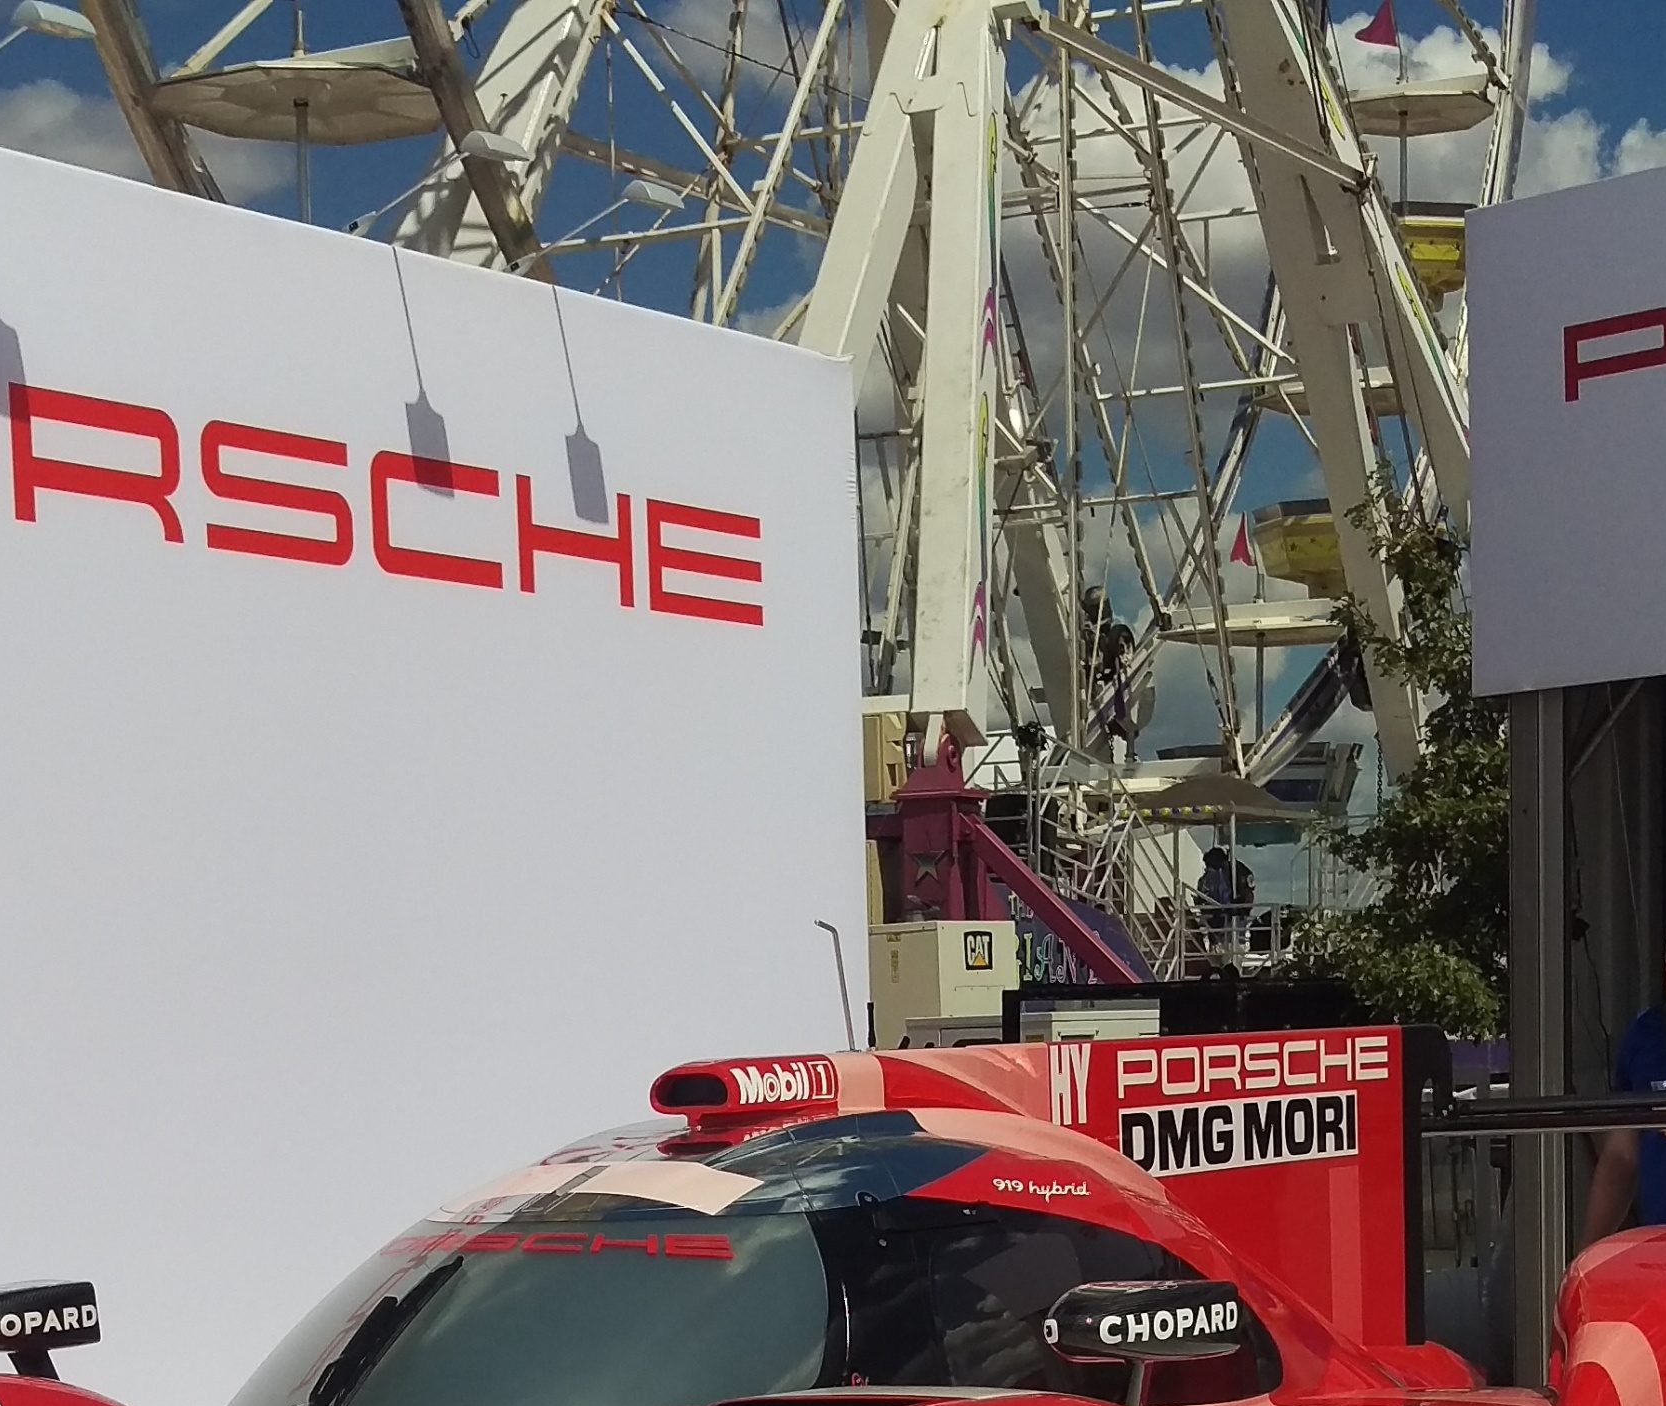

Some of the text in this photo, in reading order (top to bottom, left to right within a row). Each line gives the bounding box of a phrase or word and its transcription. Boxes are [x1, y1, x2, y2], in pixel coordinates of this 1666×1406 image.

[966, 934, 991, 967] CAT
[730, 1059, 810, 1105] Mobil
[1050, 1043, 1092, 1125] HY
[1118, 1035, 1390, 1098] PORSCHE
[1122, 1093, 1357, 1172] DMG MORI
[992, 1177, 1091, 1204] 919 hybrid
[1099, 1301, 1238, 1345] CHOPARD
